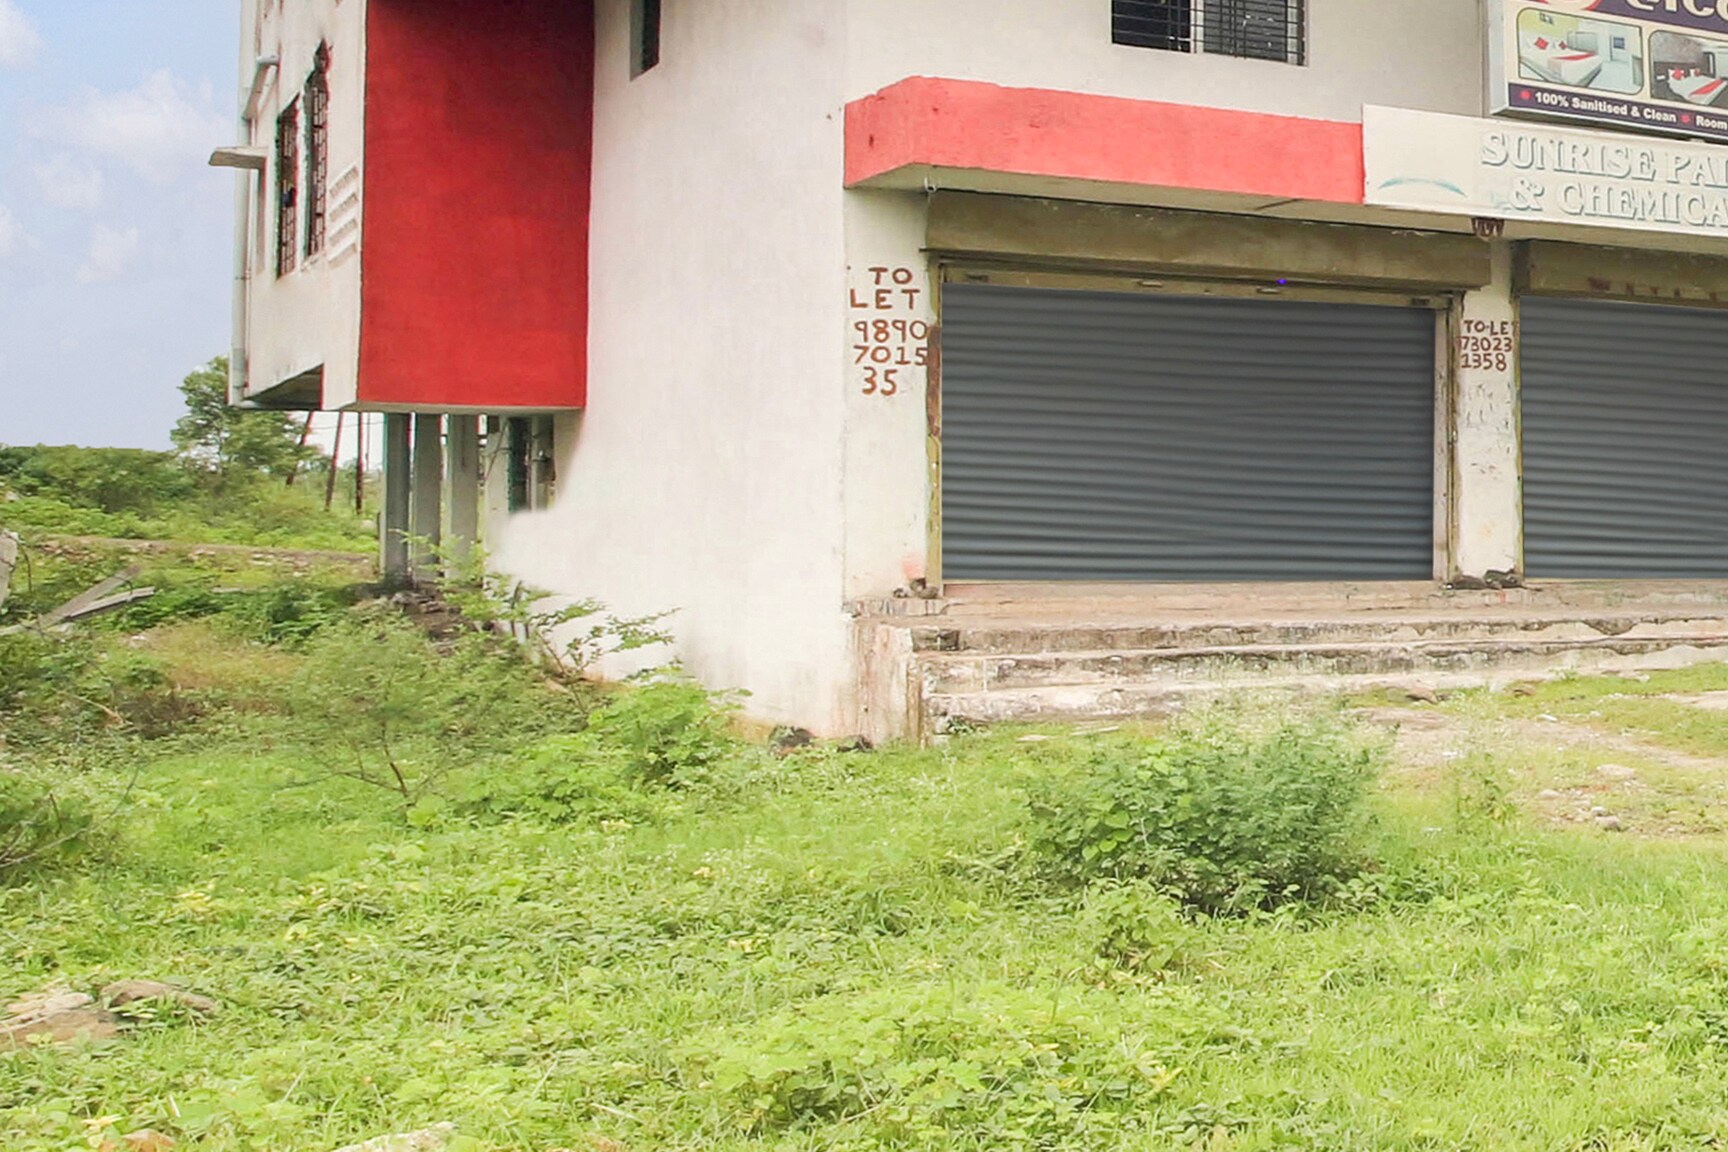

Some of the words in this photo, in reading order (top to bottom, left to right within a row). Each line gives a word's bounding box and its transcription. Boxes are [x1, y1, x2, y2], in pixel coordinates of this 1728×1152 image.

[1535, 91, 1570, 108] 100%
[1571, 97, 1629, 117] Sanitised
[1630, 105, 1641, 118] &
[1643, 108, 1678, 123] Clean
[1695, 115, 1728, 131] Room
[1481, 130, 1657, 182] SUNRISE
[1507, 174, 1546, 210] &
[868, 266, 913, 285] TO
[850, 288, 920, 310] LET
[854, 319, 929, 343] 9890
[853, 345, 928, 366] 7015
[1460, 336, 1512, 352] 73023
[1461, 353, 1507, 371] 1358
[862, 366, 898, 396] 35
